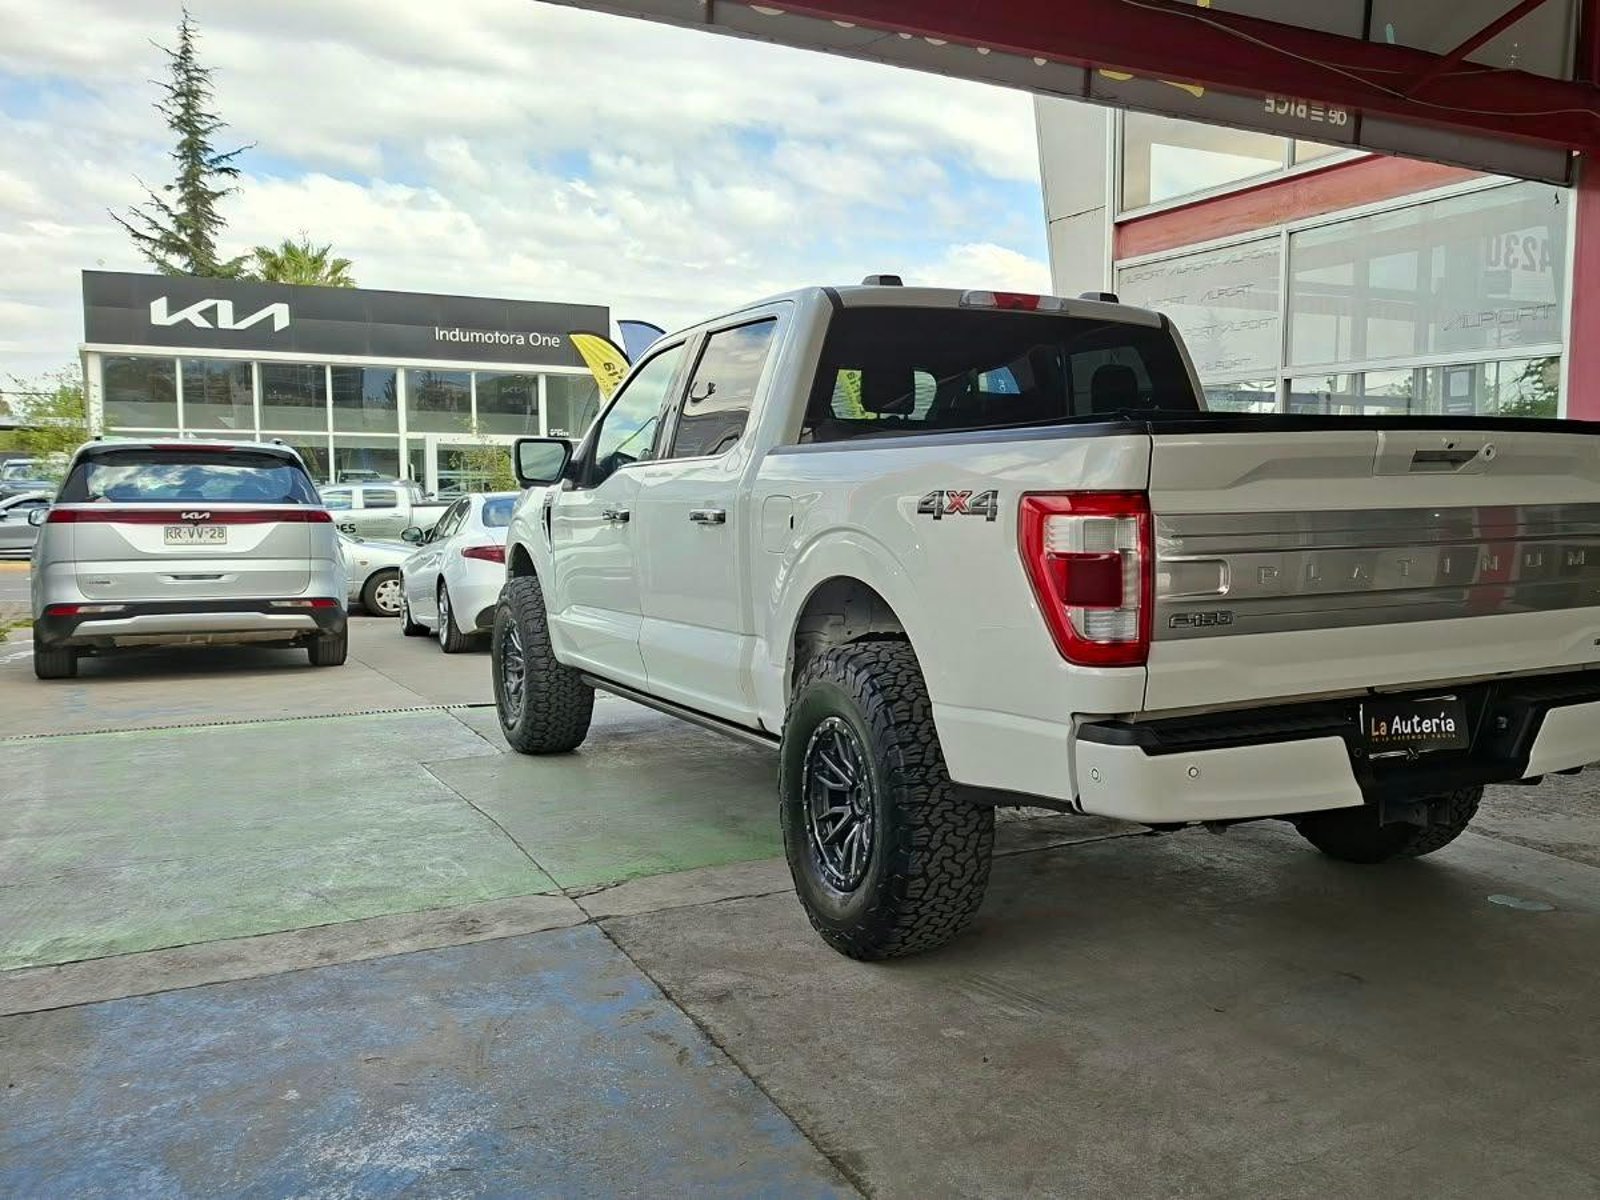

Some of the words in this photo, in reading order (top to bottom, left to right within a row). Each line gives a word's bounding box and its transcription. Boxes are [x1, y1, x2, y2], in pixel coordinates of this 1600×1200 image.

[149, 296, 290, 333] KIA
[435, 326, 525, 345] Indumotora
[529, 332, 560, 347] One
[1371, 716, 1388, 737] La
[1391, 711, 1456, 735] Autería
